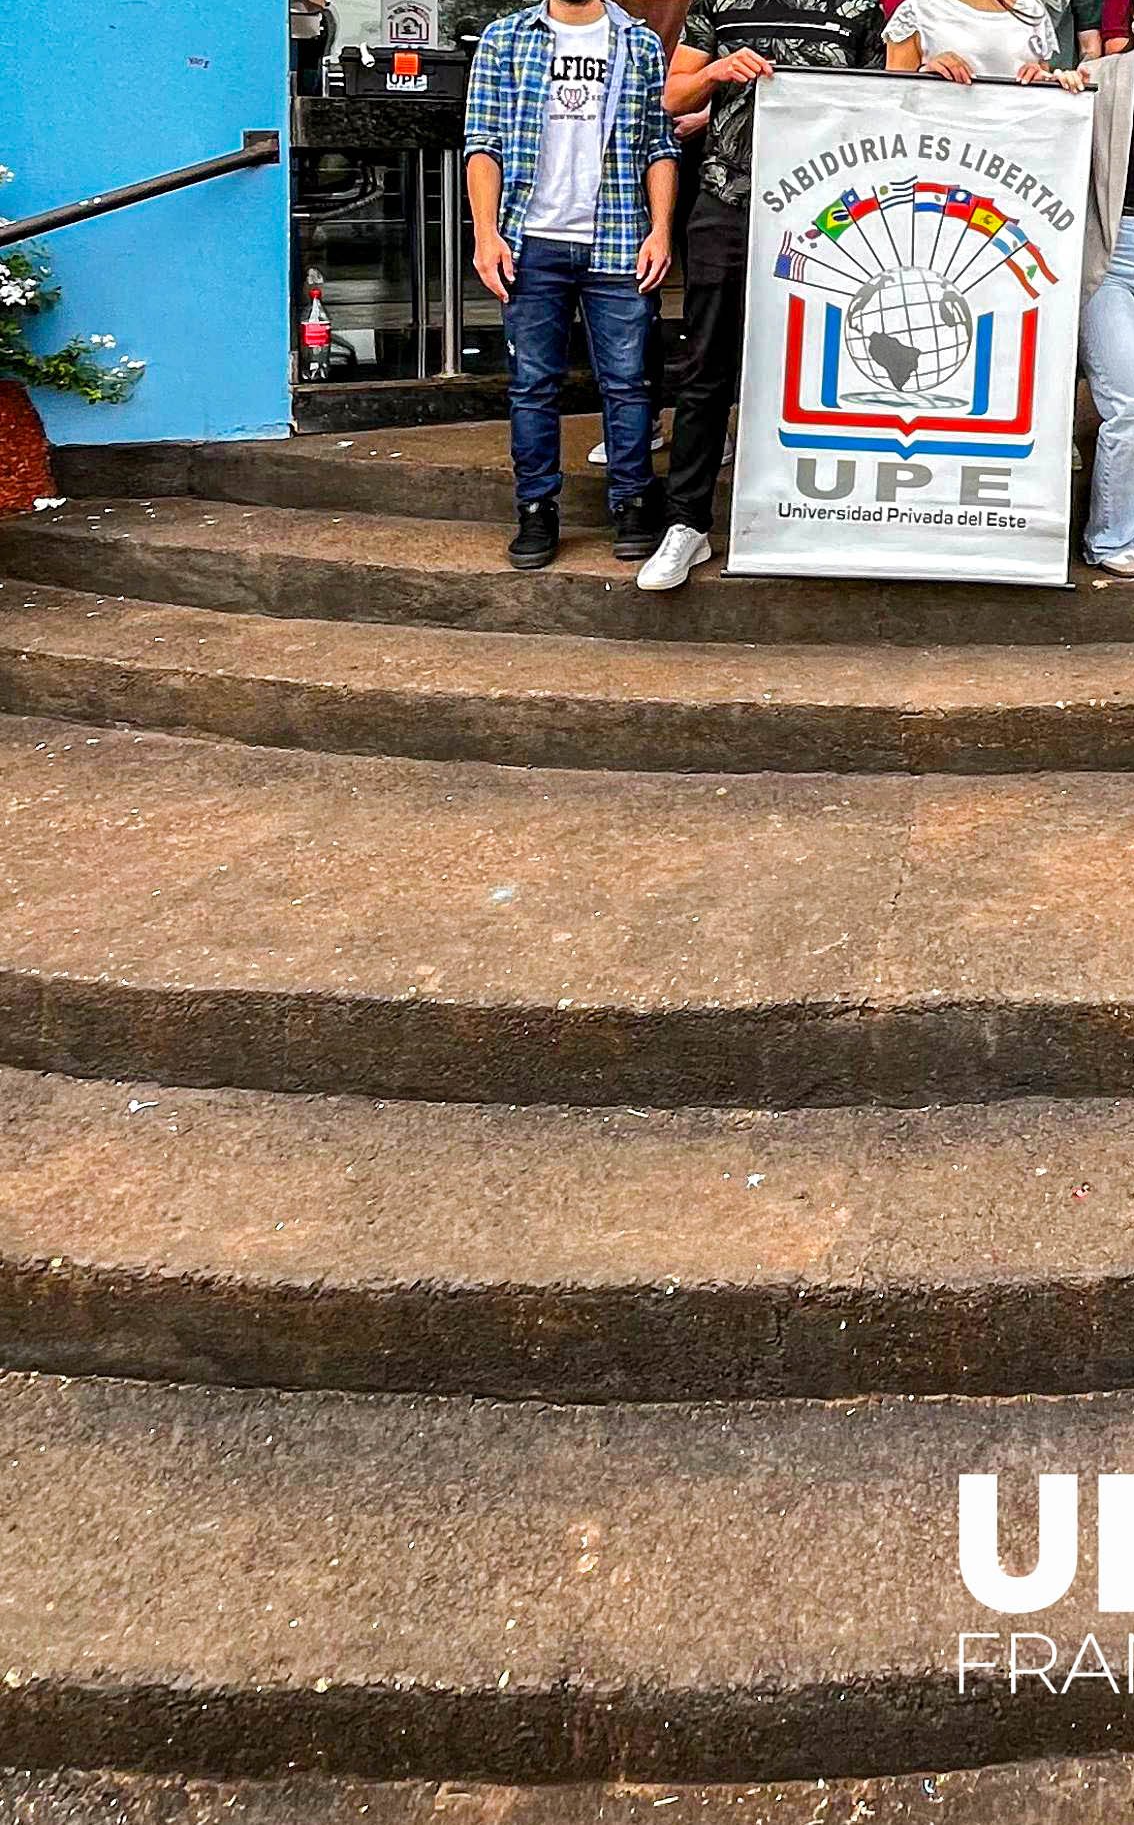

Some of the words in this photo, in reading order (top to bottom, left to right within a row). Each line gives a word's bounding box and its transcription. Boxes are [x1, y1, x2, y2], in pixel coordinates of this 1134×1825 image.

[762, 133, 908, 214] SABIDURIA
[918, 134, 951, 162] ES
[959, 142, 1076, 233] LIBERTAD
[795, 457, 1013, 508] UPE
[778, 502, 882, 522] Universidad
[887, 507, 953, 525] Privada
[957, 510, 982, 527] del
[986, 512, 1027, 529] Este
